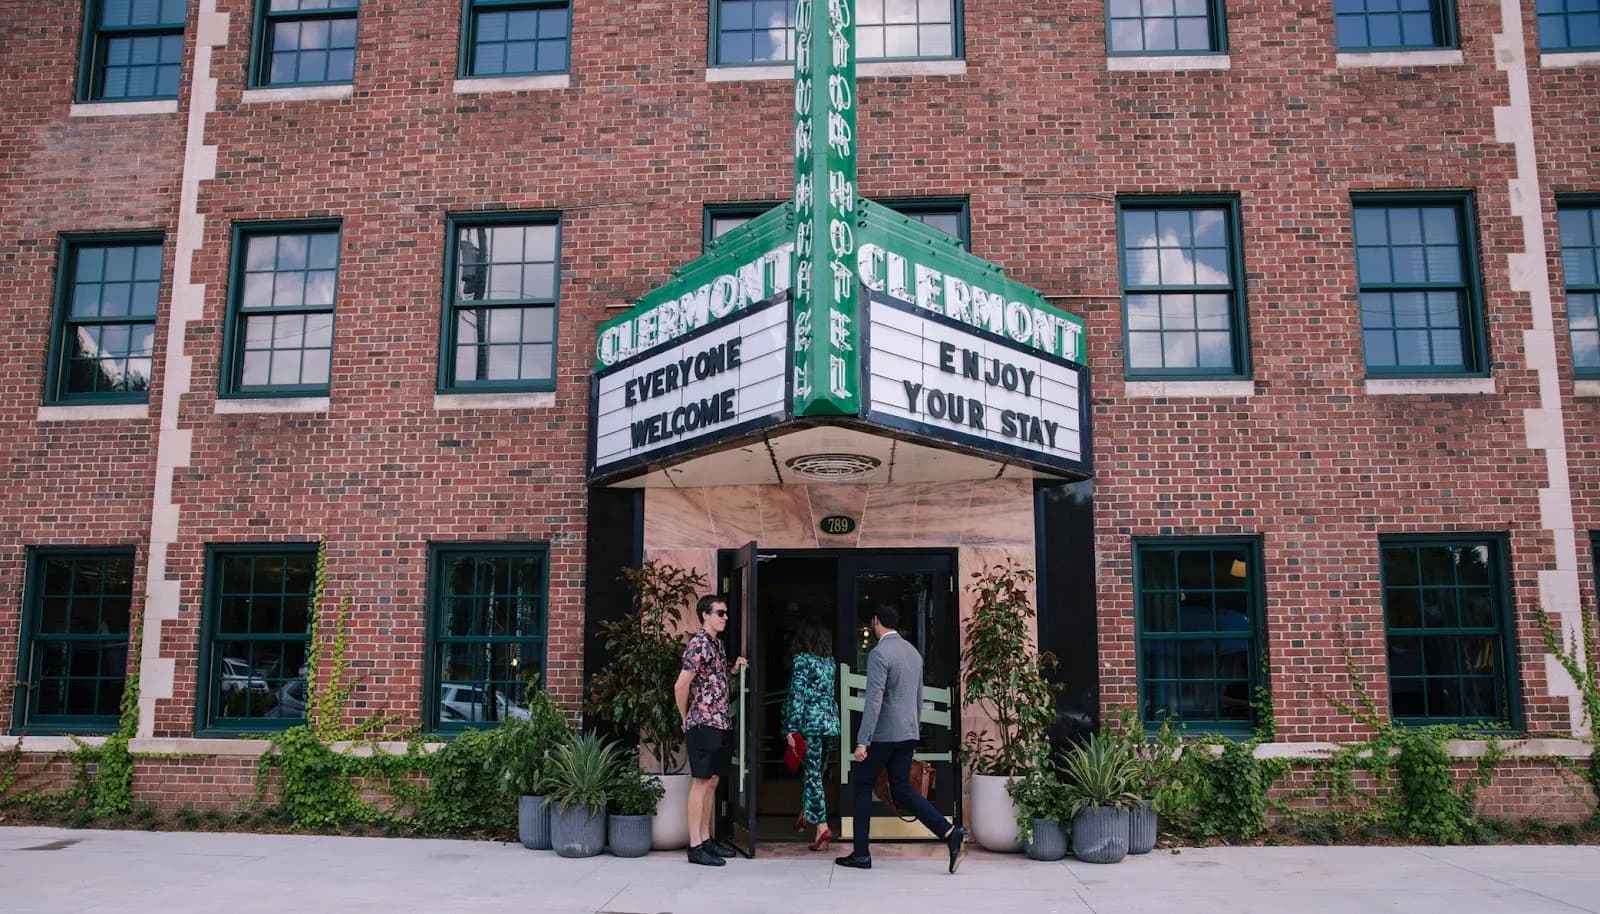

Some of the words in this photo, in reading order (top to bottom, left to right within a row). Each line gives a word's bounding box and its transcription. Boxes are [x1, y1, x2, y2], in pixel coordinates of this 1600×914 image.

[597, 242, 794, 366] CLERMONT
[828, 169, 853, 400] HOTEL
[857, 243, 1082, 362] CLERMONT
[625, 336, 742, 408] EVERYONE
[940, 341, 1035, 397] ENJOY
[630, 388, 736, 449] WELCOME
[903, 380, 985, 430] YOUR
[1001, 409, 1059, 448] STAY
[828, 518, 848, 532] 789
